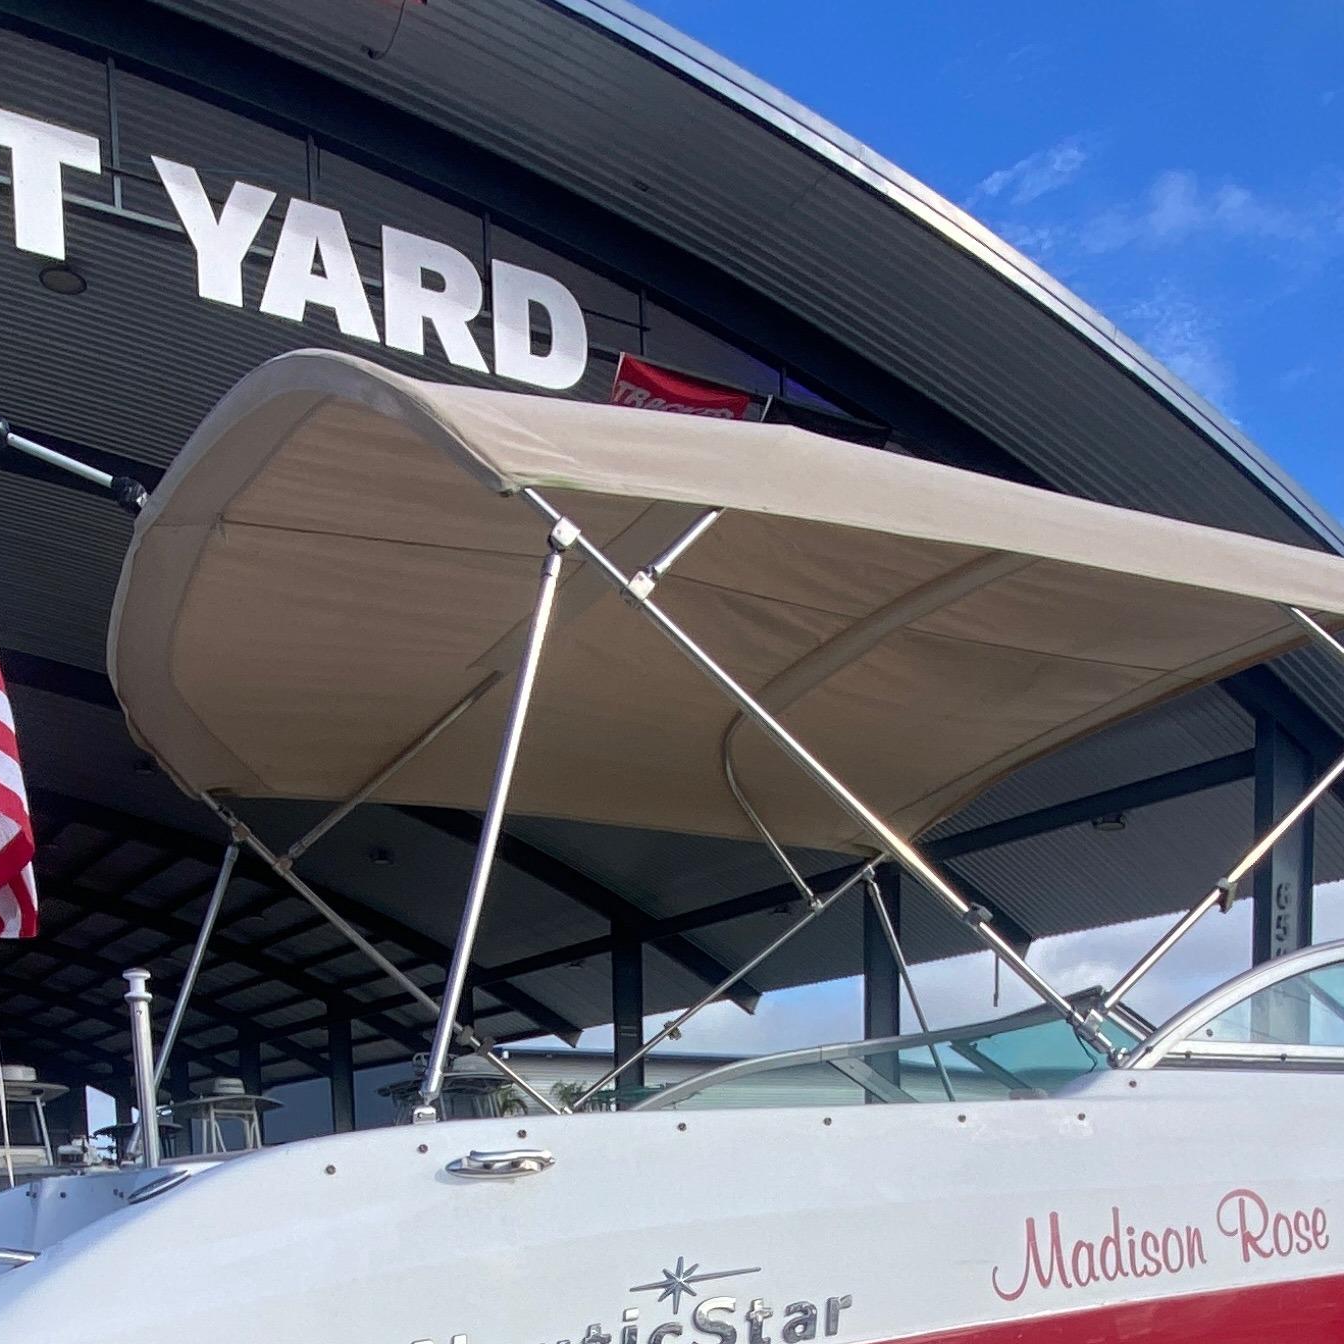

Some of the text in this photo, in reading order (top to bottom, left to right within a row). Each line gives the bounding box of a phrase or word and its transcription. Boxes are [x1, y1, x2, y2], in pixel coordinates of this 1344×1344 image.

[151, 155, 588, 390] YARD
[992, 1188, 1330, 1301] Madison Rose
